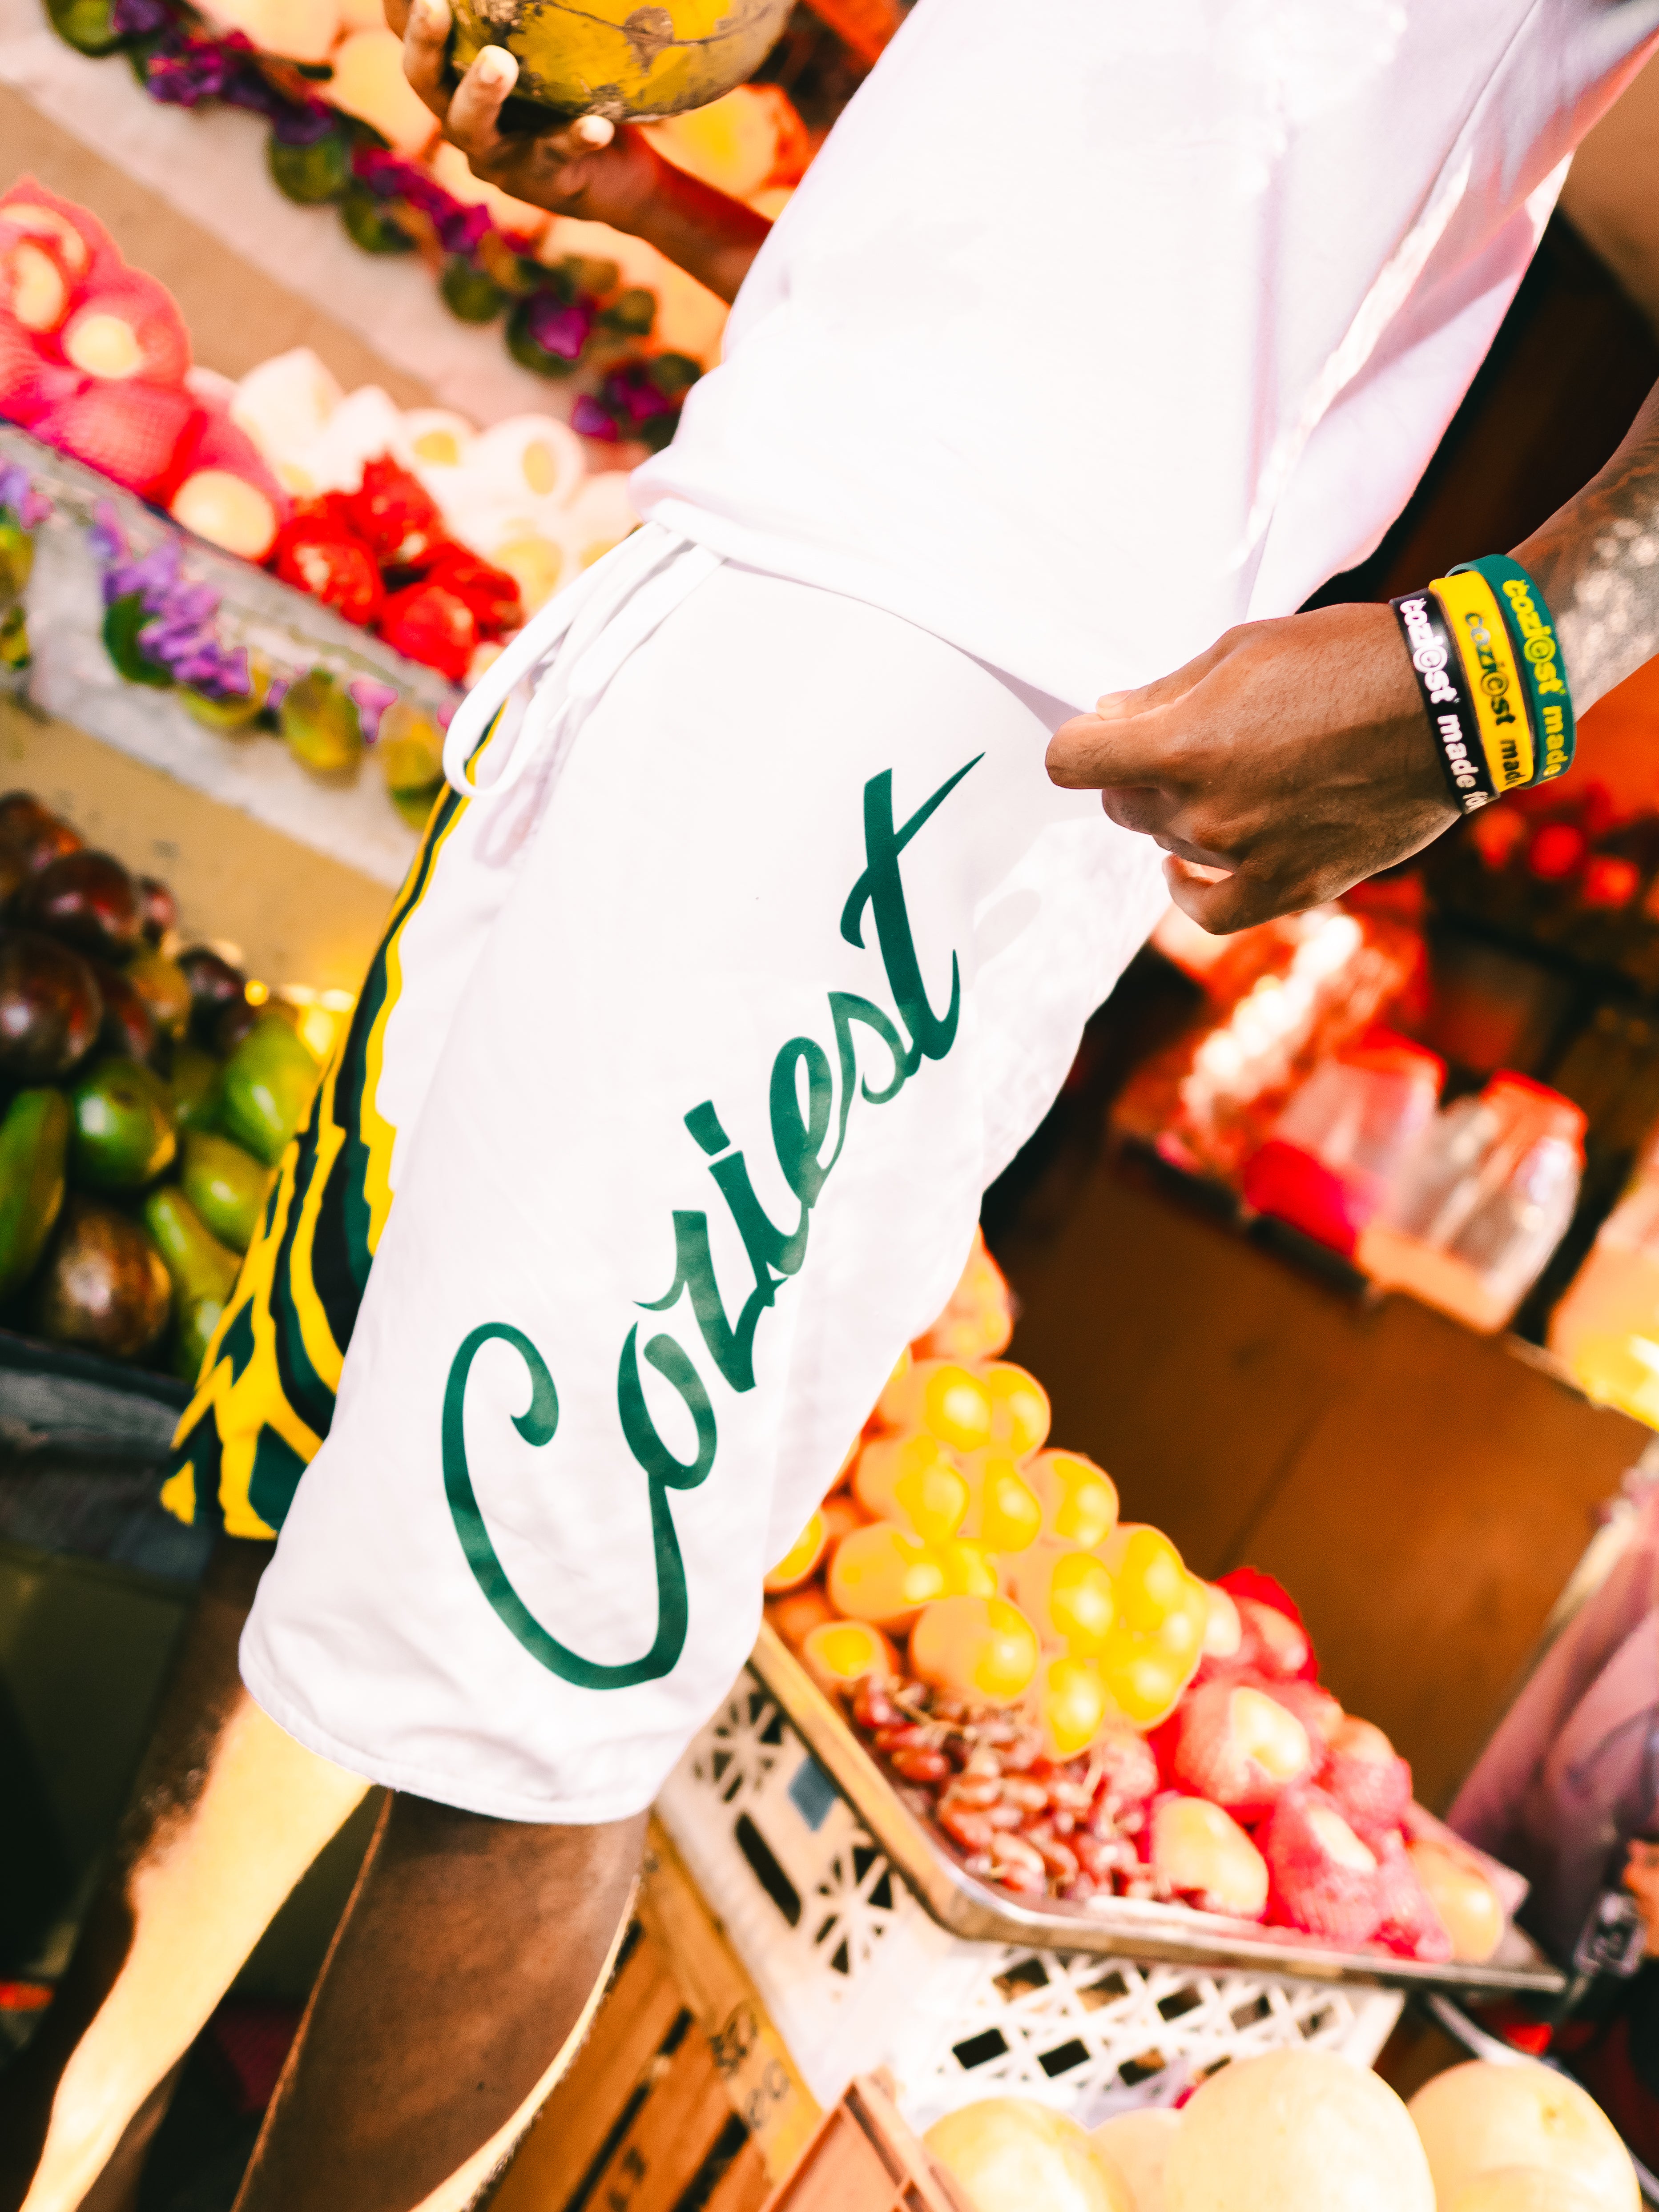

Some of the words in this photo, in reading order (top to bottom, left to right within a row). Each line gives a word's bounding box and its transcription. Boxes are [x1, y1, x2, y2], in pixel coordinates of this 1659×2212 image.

[1437, 714, 1478, 788] made
[1542, 706, 1568, 777] made
[442, 752, 985, 1689] Coziest
